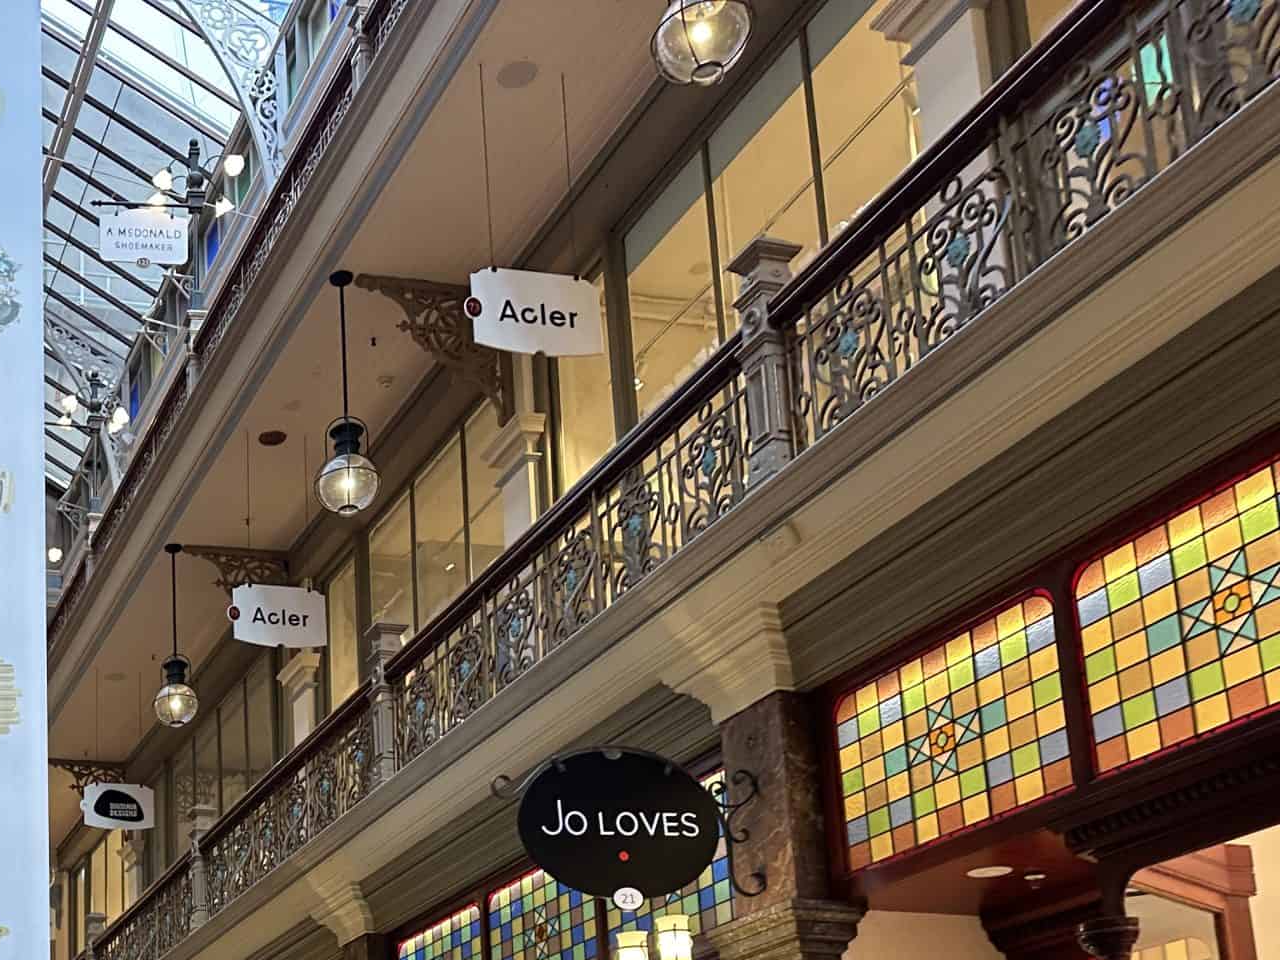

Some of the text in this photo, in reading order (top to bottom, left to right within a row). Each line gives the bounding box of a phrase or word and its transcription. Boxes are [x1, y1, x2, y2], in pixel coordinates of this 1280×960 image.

[106, 227, 113, 237] A
[499, 299, 578, 329] Acler
[252, 606, 309, 627] Acler
[597, 810, 700, 837] LOVES
[621, 893, 635, 905] 21
